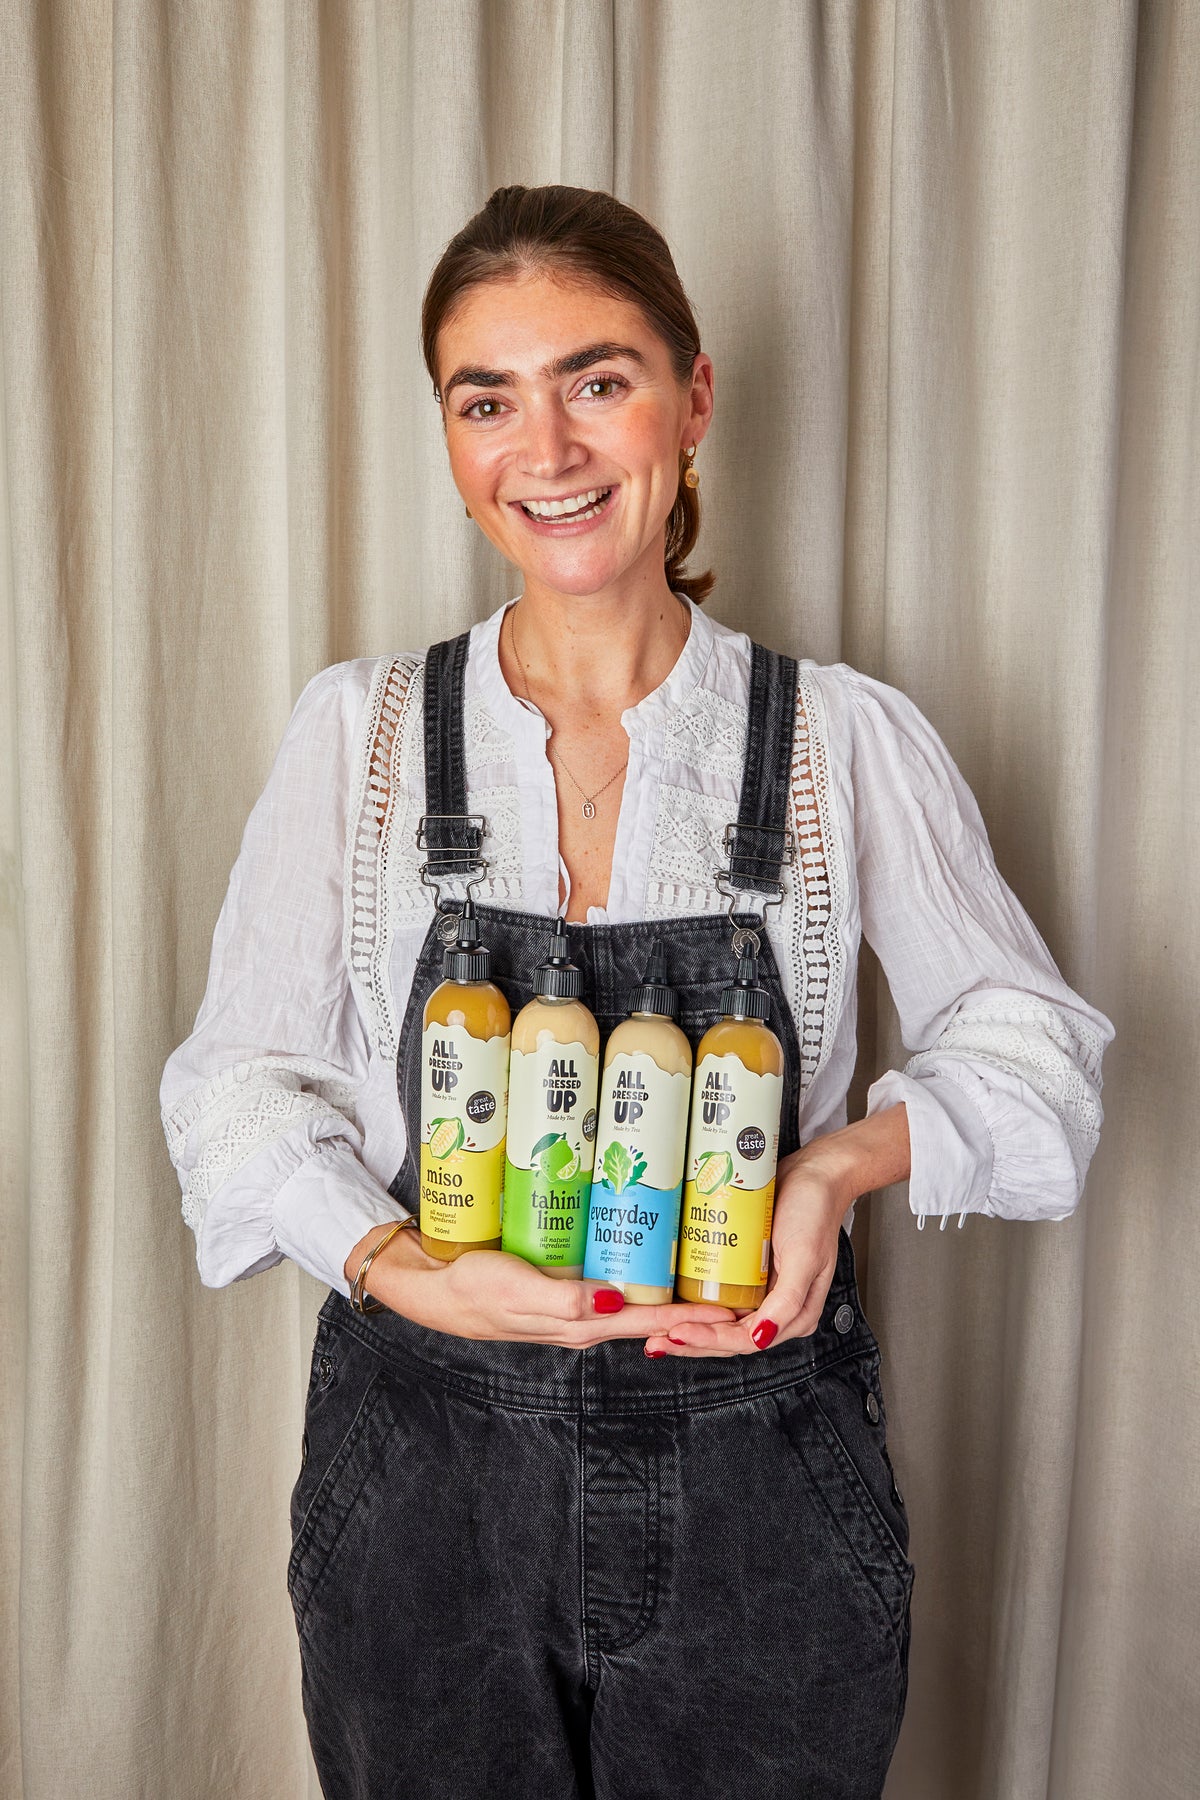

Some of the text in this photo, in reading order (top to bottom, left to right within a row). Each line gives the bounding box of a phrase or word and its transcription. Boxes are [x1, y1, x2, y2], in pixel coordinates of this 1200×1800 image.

[432, 1039, 458, 1059] ALL
[429, 1057, 463, 1070] DRESSED
[548, 1059, 578, 1078] ALL
[431, 1068, 459, 1093] UP
[542, 1078, 582, 1089] DRESSED
[616, 1070, 646, 1090] ALL
[704, 1071, 732, 1091] ALL
[473, 1096, 489, 1106] great
[546, 1089, 577, 1113] UP
[612, 1090, 649, 1102] DRESSED
[701, 1090, 736, 1103] DRESSED
[468, 1101, 495, 1115] taste
[614, 1100, 644, 1125] UP
[702, 1101, 731, 1126] UP
[738, 1138, 765, 1150] taste
[744, 1133, 759, 1142] great
[427, 1166, 463, 1188] miso
[422, 1185, 474, 1208] sesame
[532, 1189, 581, 1210] tahini
[430, 1215, 457, 1224] ingredients
[537, 1210, 575, 1231] lime
[590, 1203, 660, 1231] everyday
[690, 1202, 728, 1225] miso
[434, 1226, 450, 1235] 250ml
[594, 1221, 644, 1247] house
[682, 1225, 738, 1248] sesame
[549, 1236, 571, 1244] natural
[599, 1256, 631, 1264] ingredients
[690, 1254, 719, 1263] ingredients
[697, 1250, 719, 1258] natural
[604, 1267, 623, 1276] 250ml
[694, 1266, 711, 1274] 250ml
